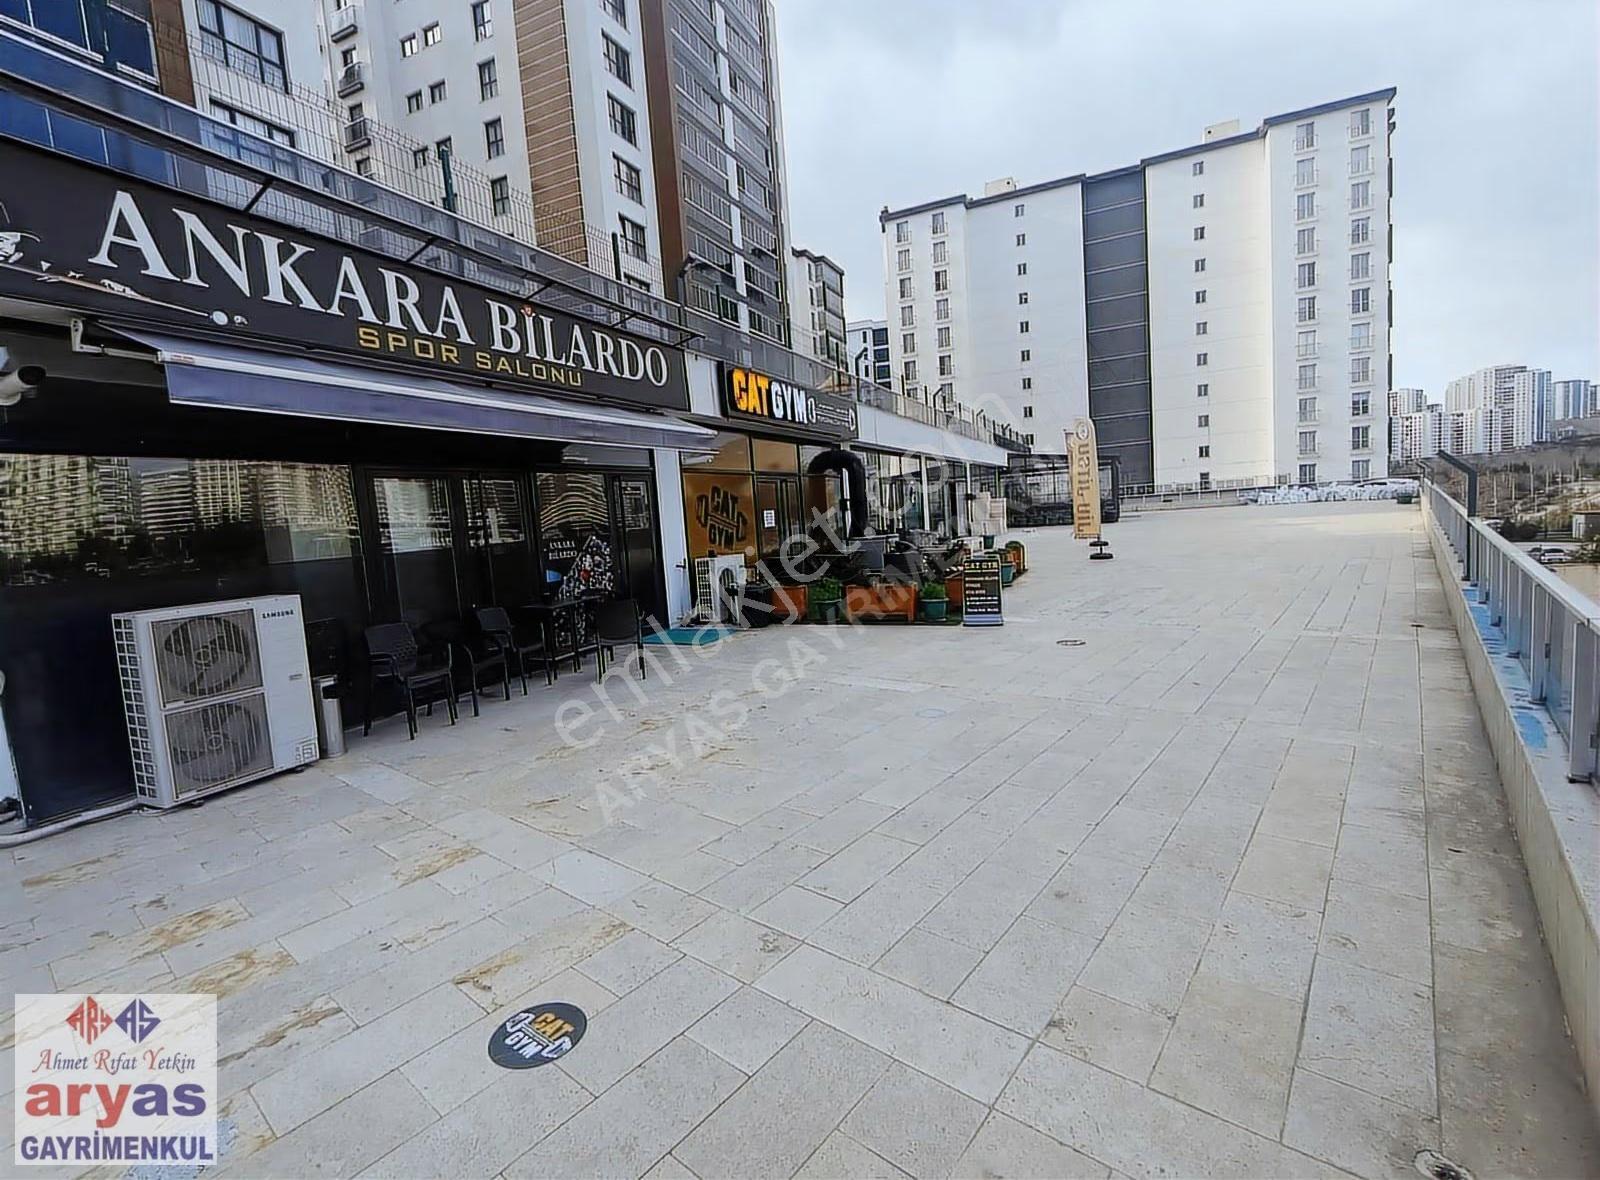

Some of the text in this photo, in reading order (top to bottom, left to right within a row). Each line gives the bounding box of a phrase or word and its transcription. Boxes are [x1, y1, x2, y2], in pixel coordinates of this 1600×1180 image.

[88, 190, 669, 387] ANKARA BİLARDO
[358, 327, 583, 387] SPOR SALONU
[732, 367, 808, 425] CAT GYM
[709, 486, 738, 522] CAT
[708, 522, 735, 551] GYM
[262, 609, 294, 619] SAMSUNG
[532, 1012, 575, 1041] CAT
[504, 1031, 543, 1059] GYM
